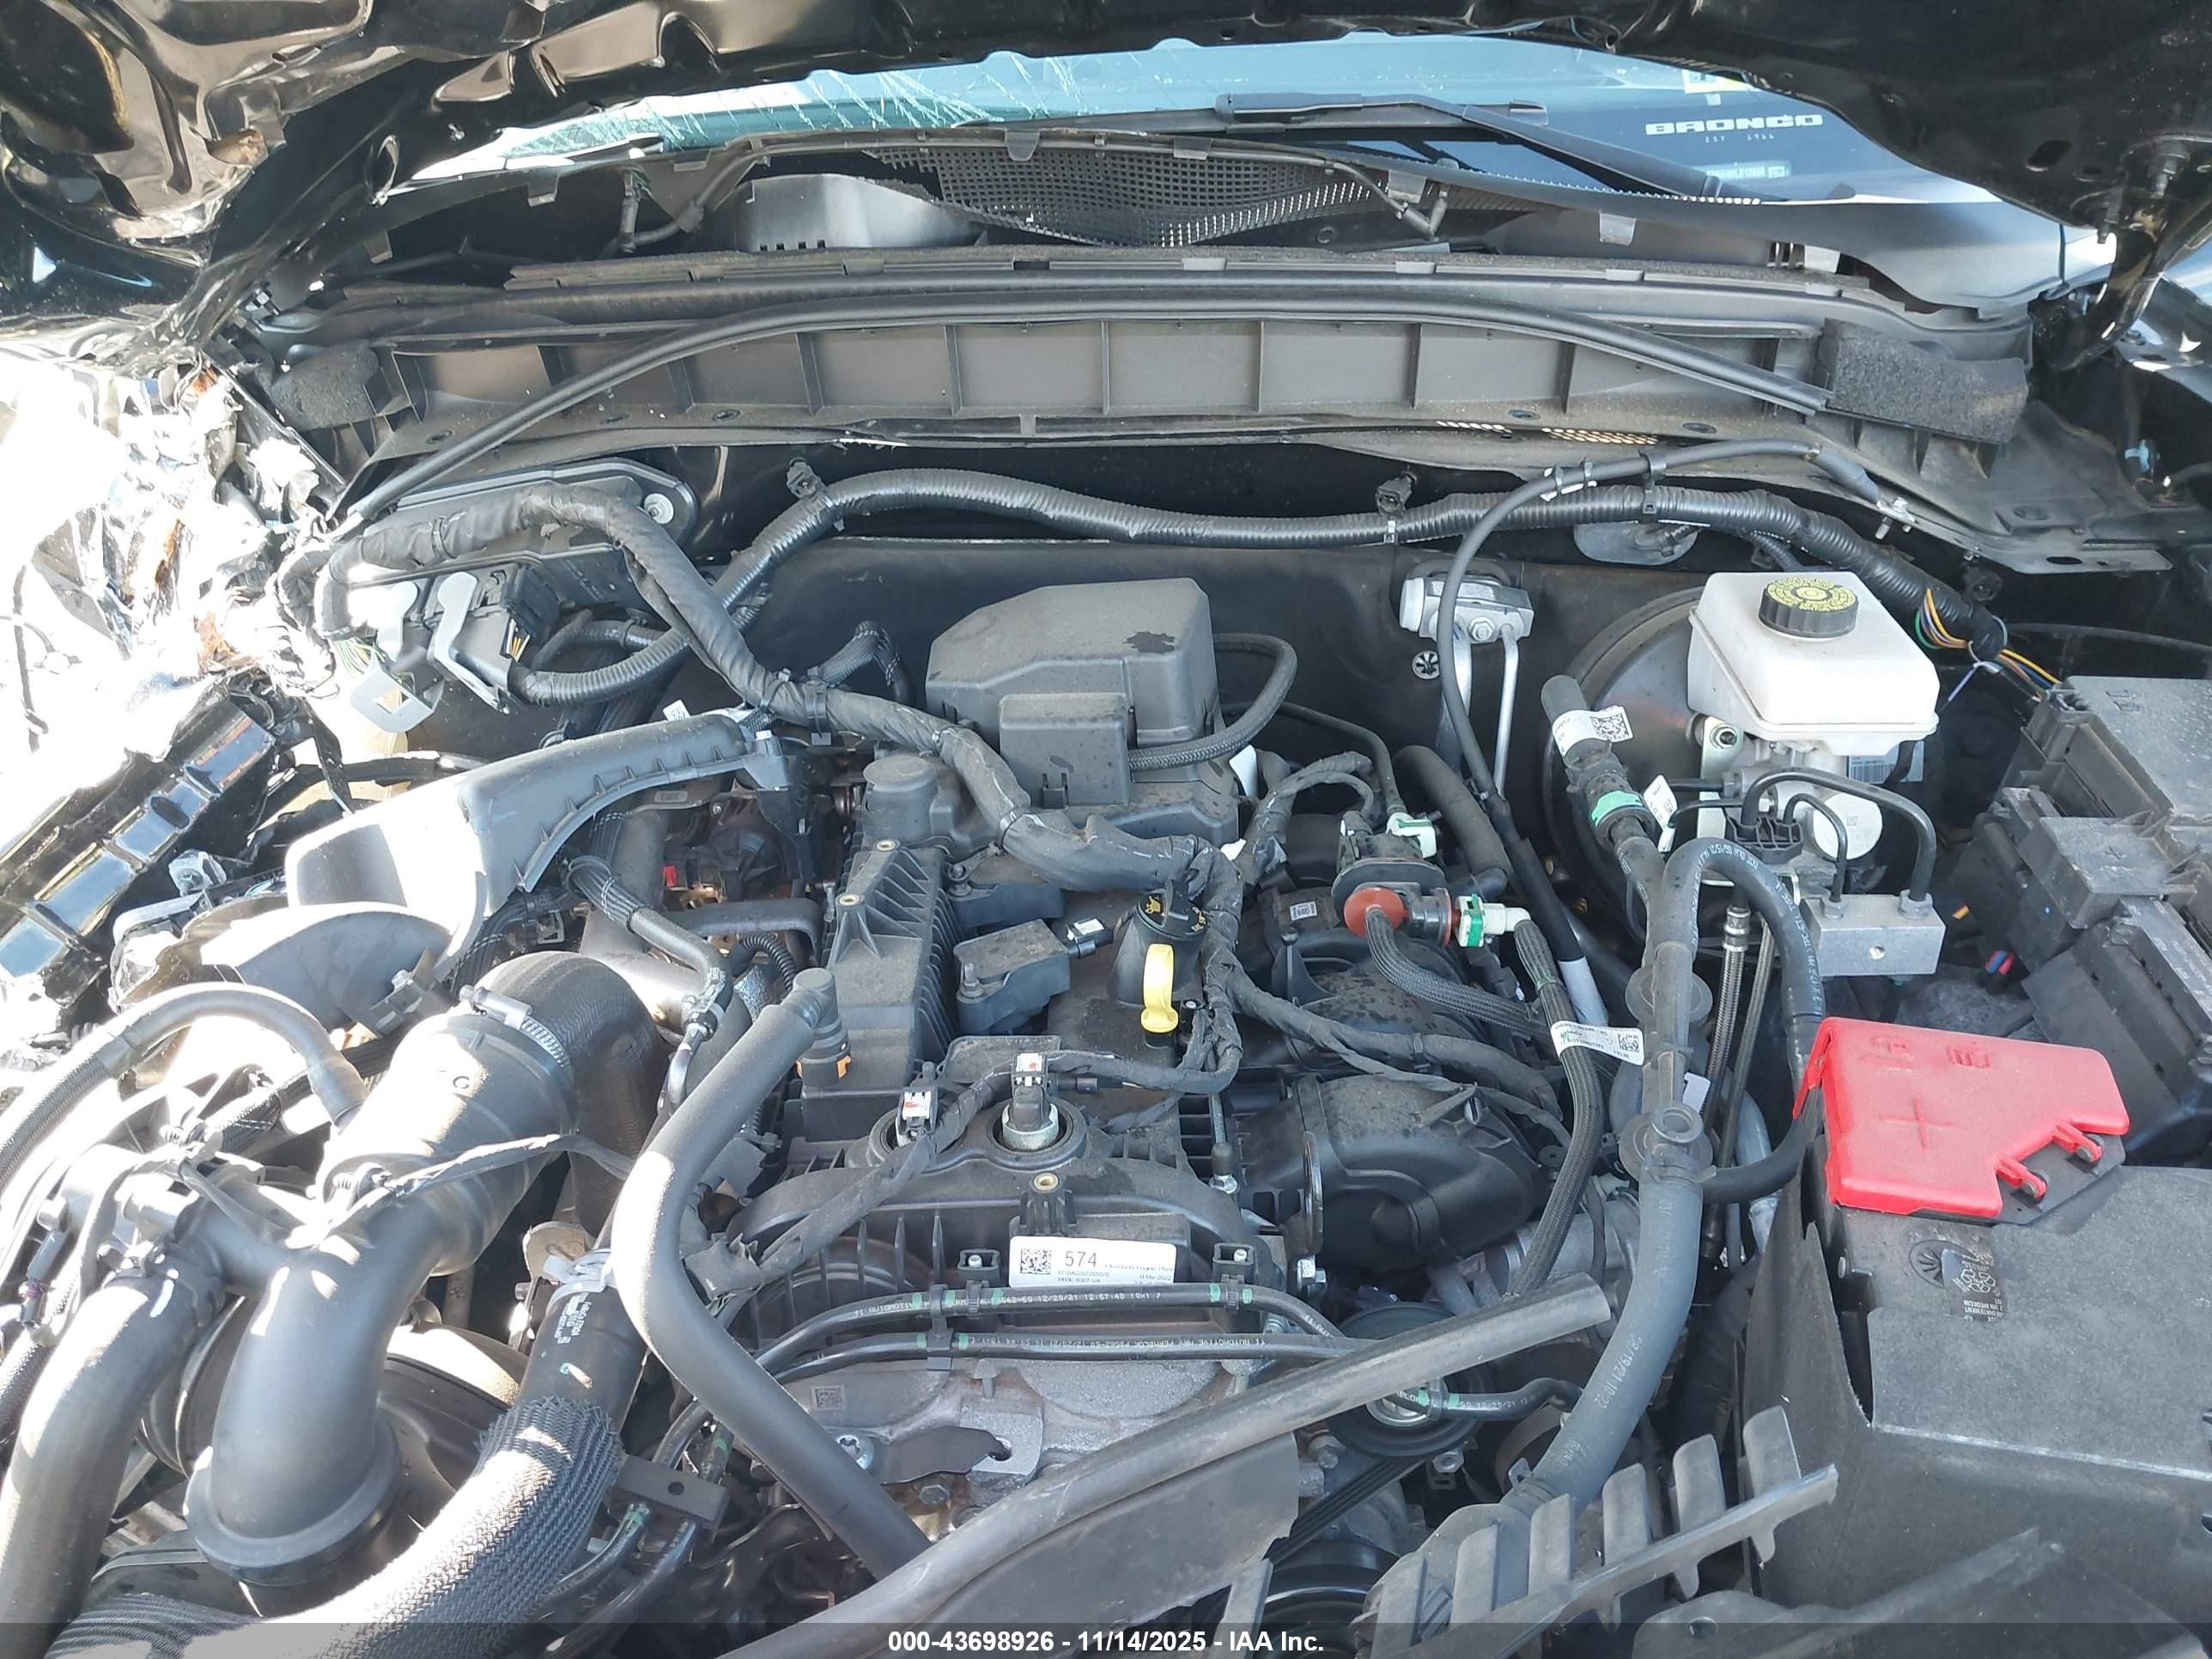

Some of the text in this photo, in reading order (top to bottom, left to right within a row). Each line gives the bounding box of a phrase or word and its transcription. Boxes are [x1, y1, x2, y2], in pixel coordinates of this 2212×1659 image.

[1644, 114, 1824, 136] BRONCO
[1064, 1250, 1097, 1267] 574
[868, 1302, 917, 1314] AUTOMOTIV
